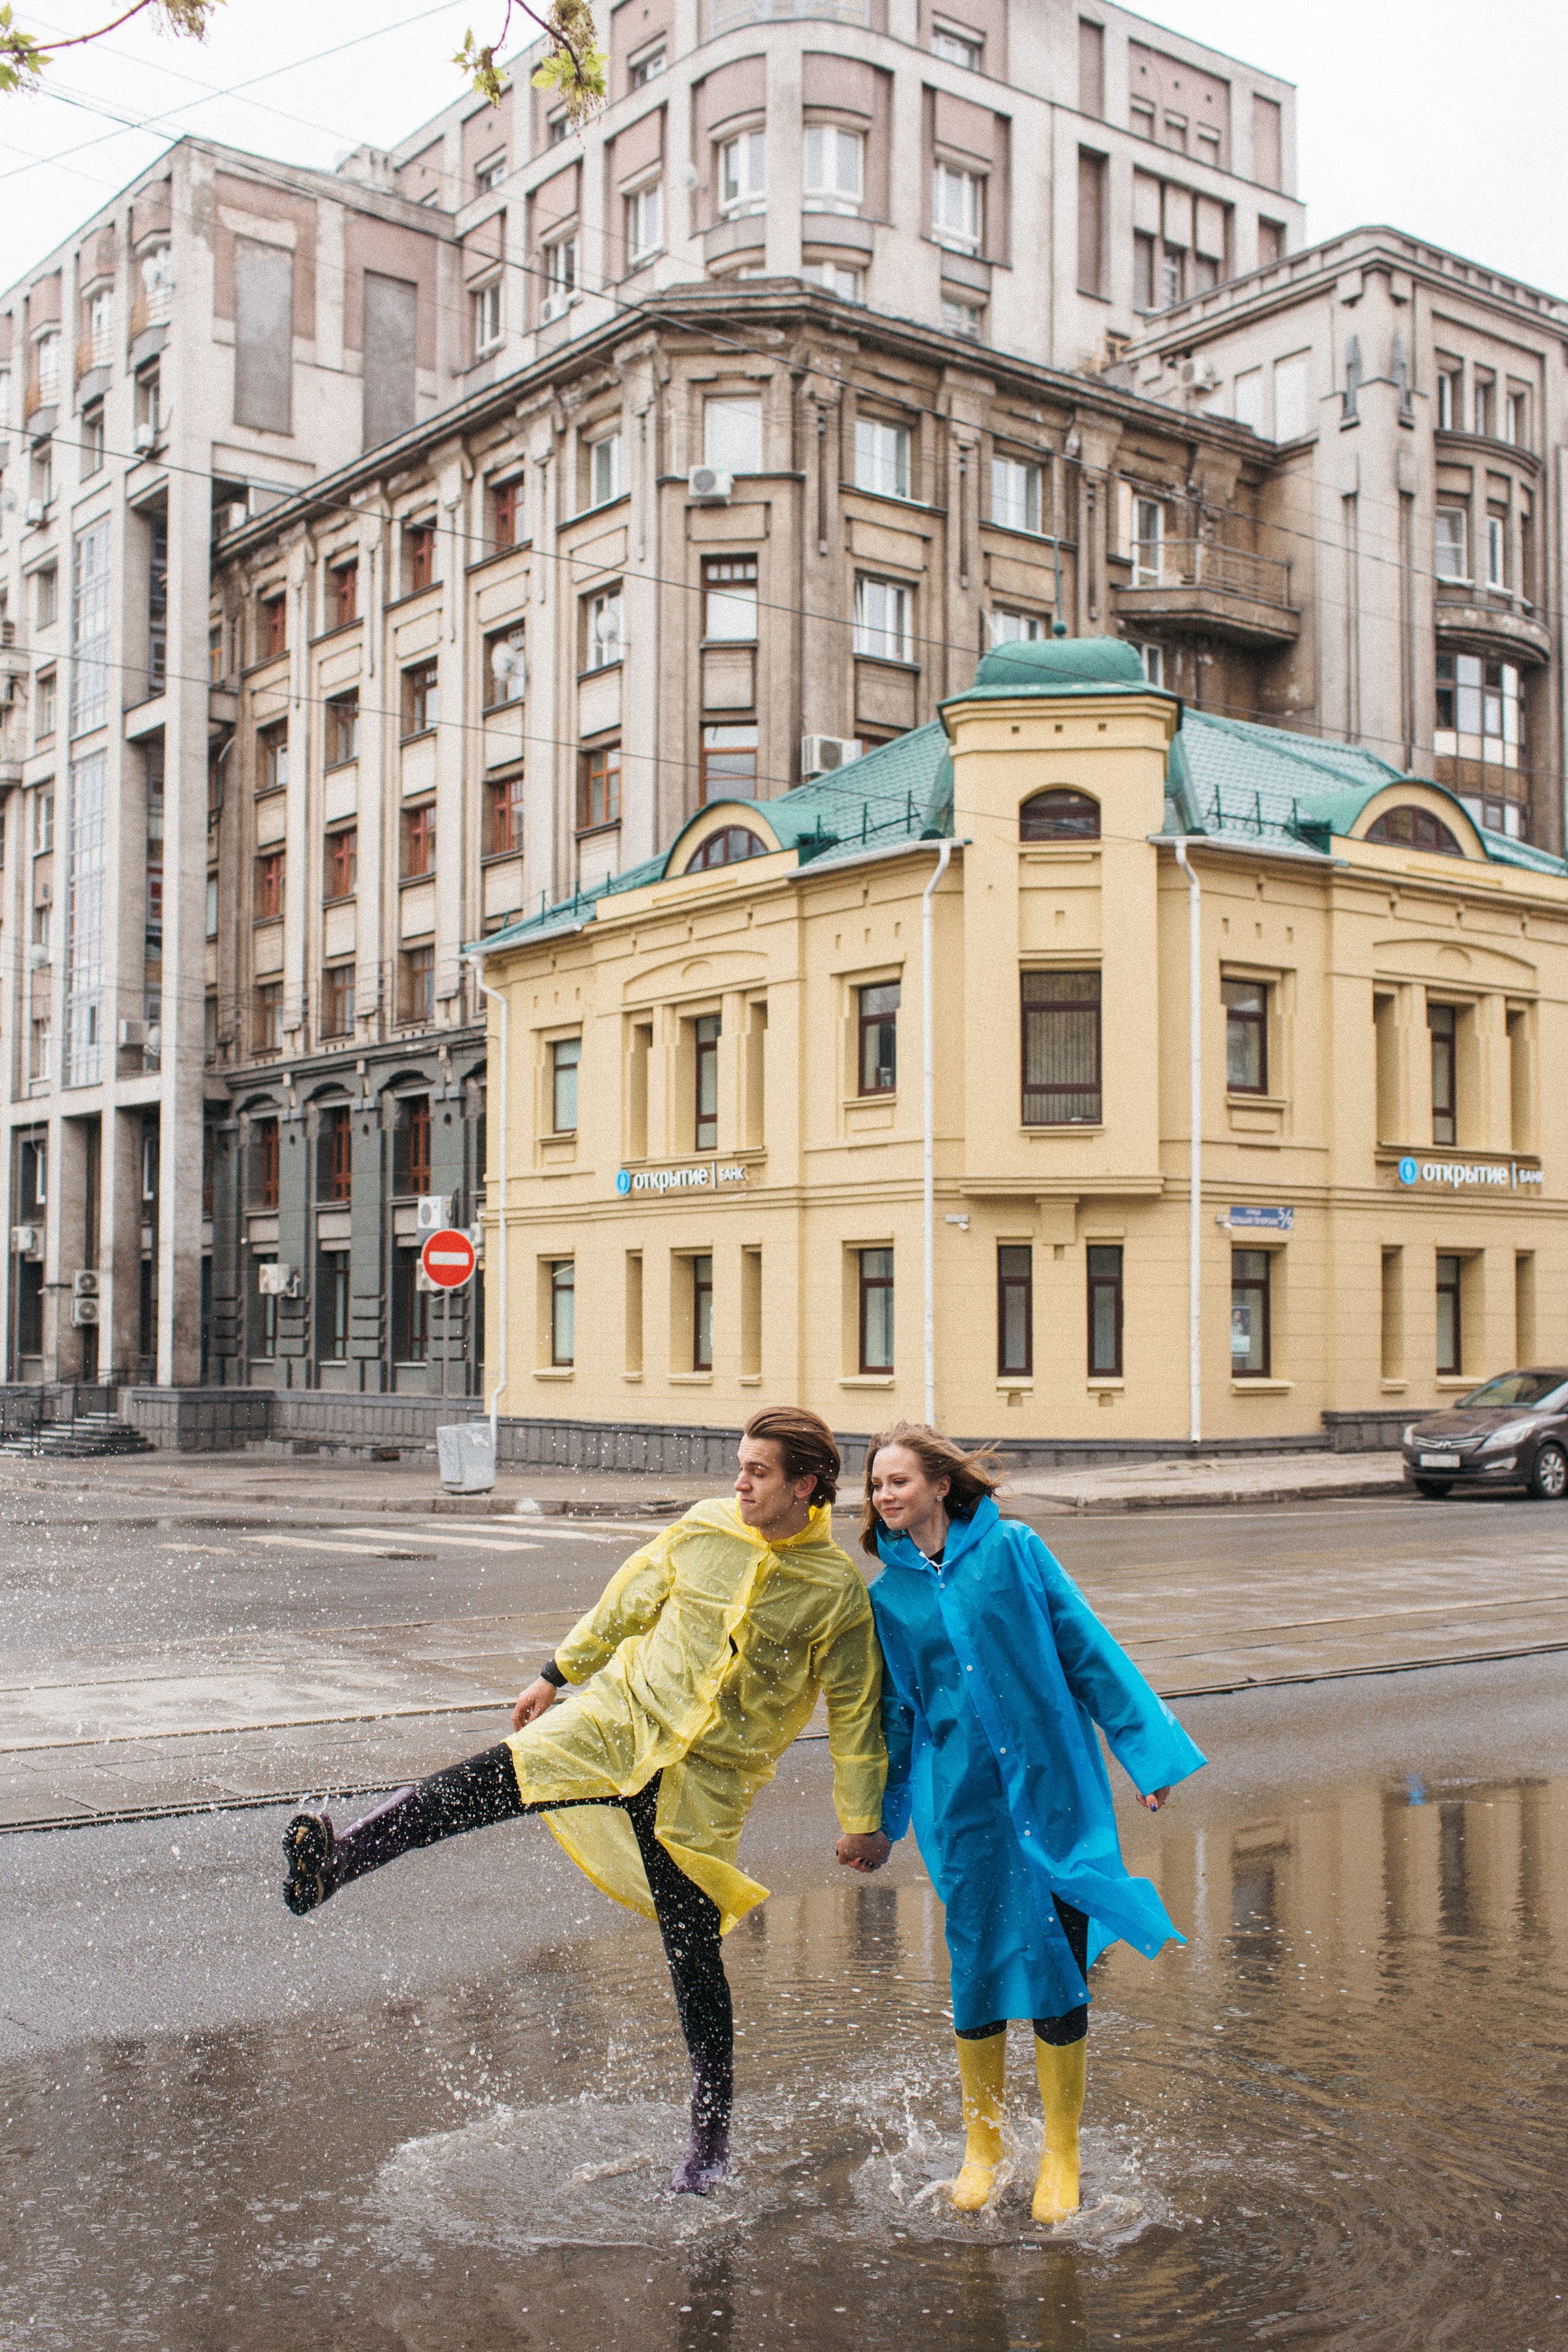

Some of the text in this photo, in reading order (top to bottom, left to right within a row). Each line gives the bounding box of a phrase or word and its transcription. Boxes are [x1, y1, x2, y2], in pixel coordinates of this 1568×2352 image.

[633, 1167, 745, 1194] открытие БАНК
[1422, 1163, 1508, 1189] открытие
